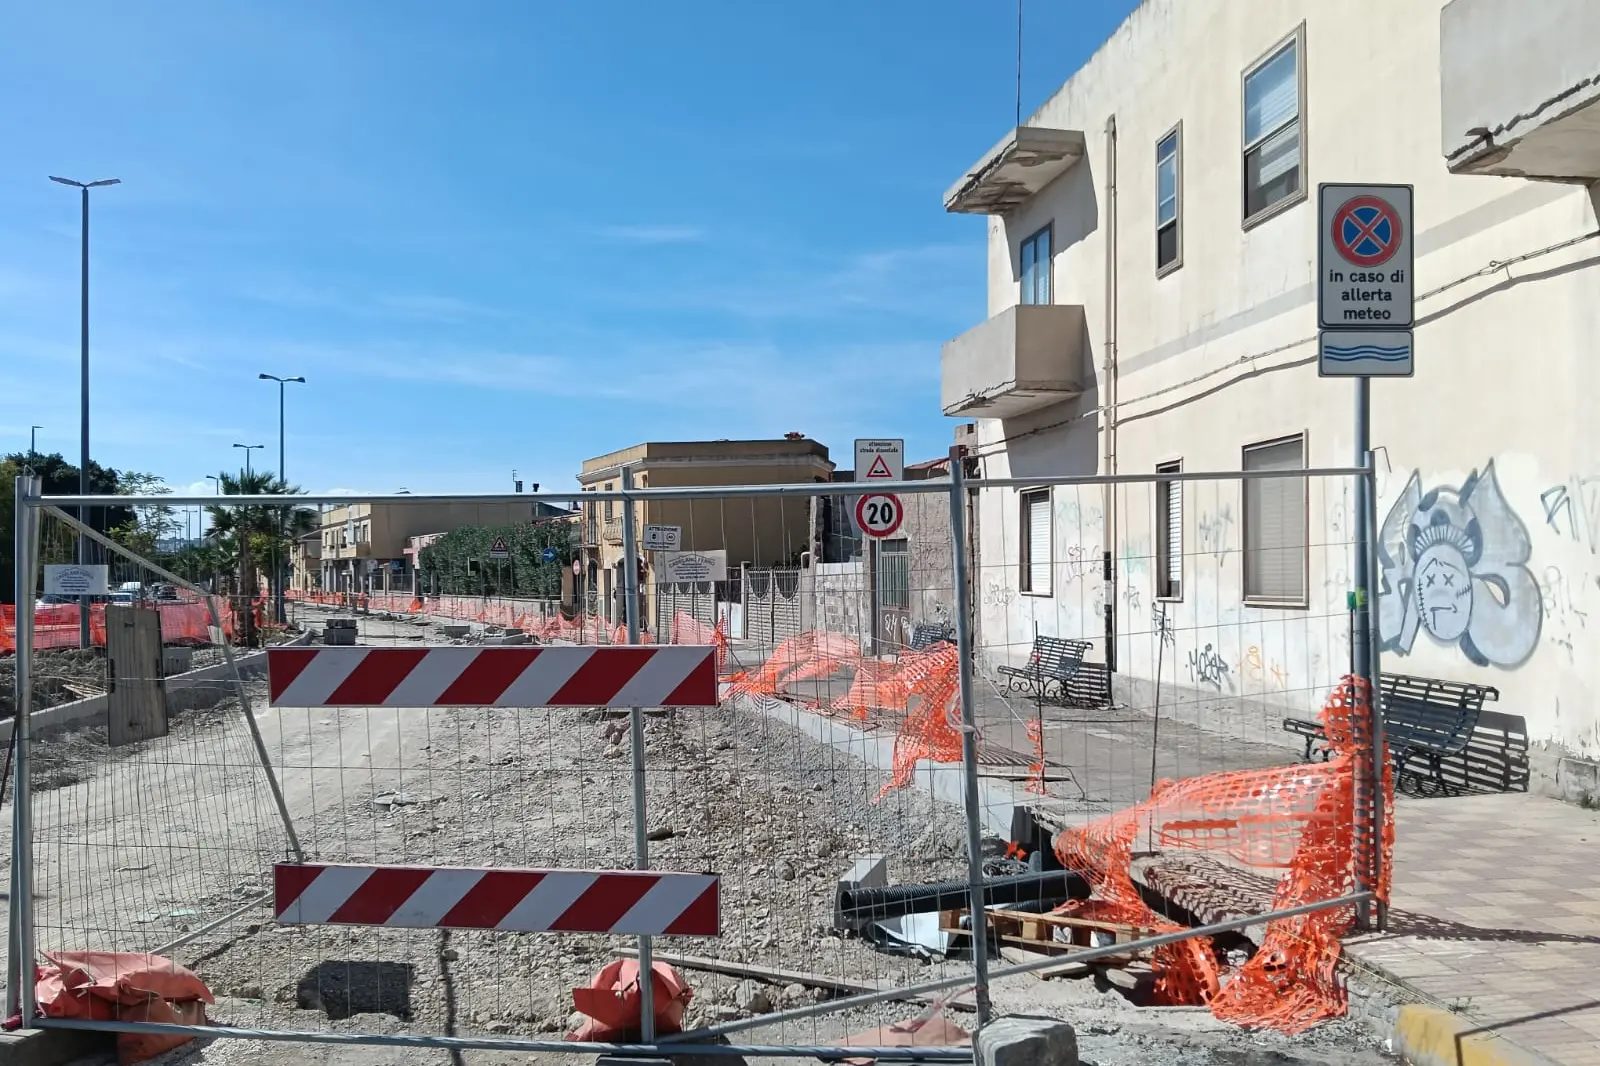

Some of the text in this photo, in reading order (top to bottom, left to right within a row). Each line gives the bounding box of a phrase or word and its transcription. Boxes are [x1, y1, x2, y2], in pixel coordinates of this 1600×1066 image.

[1329, 269, 1404, 283] in caso di
[1341, 288, 1392, 301] allerta
[1343, 307, 1391, 320] meteo
[867, 502, 893, 525] 20
